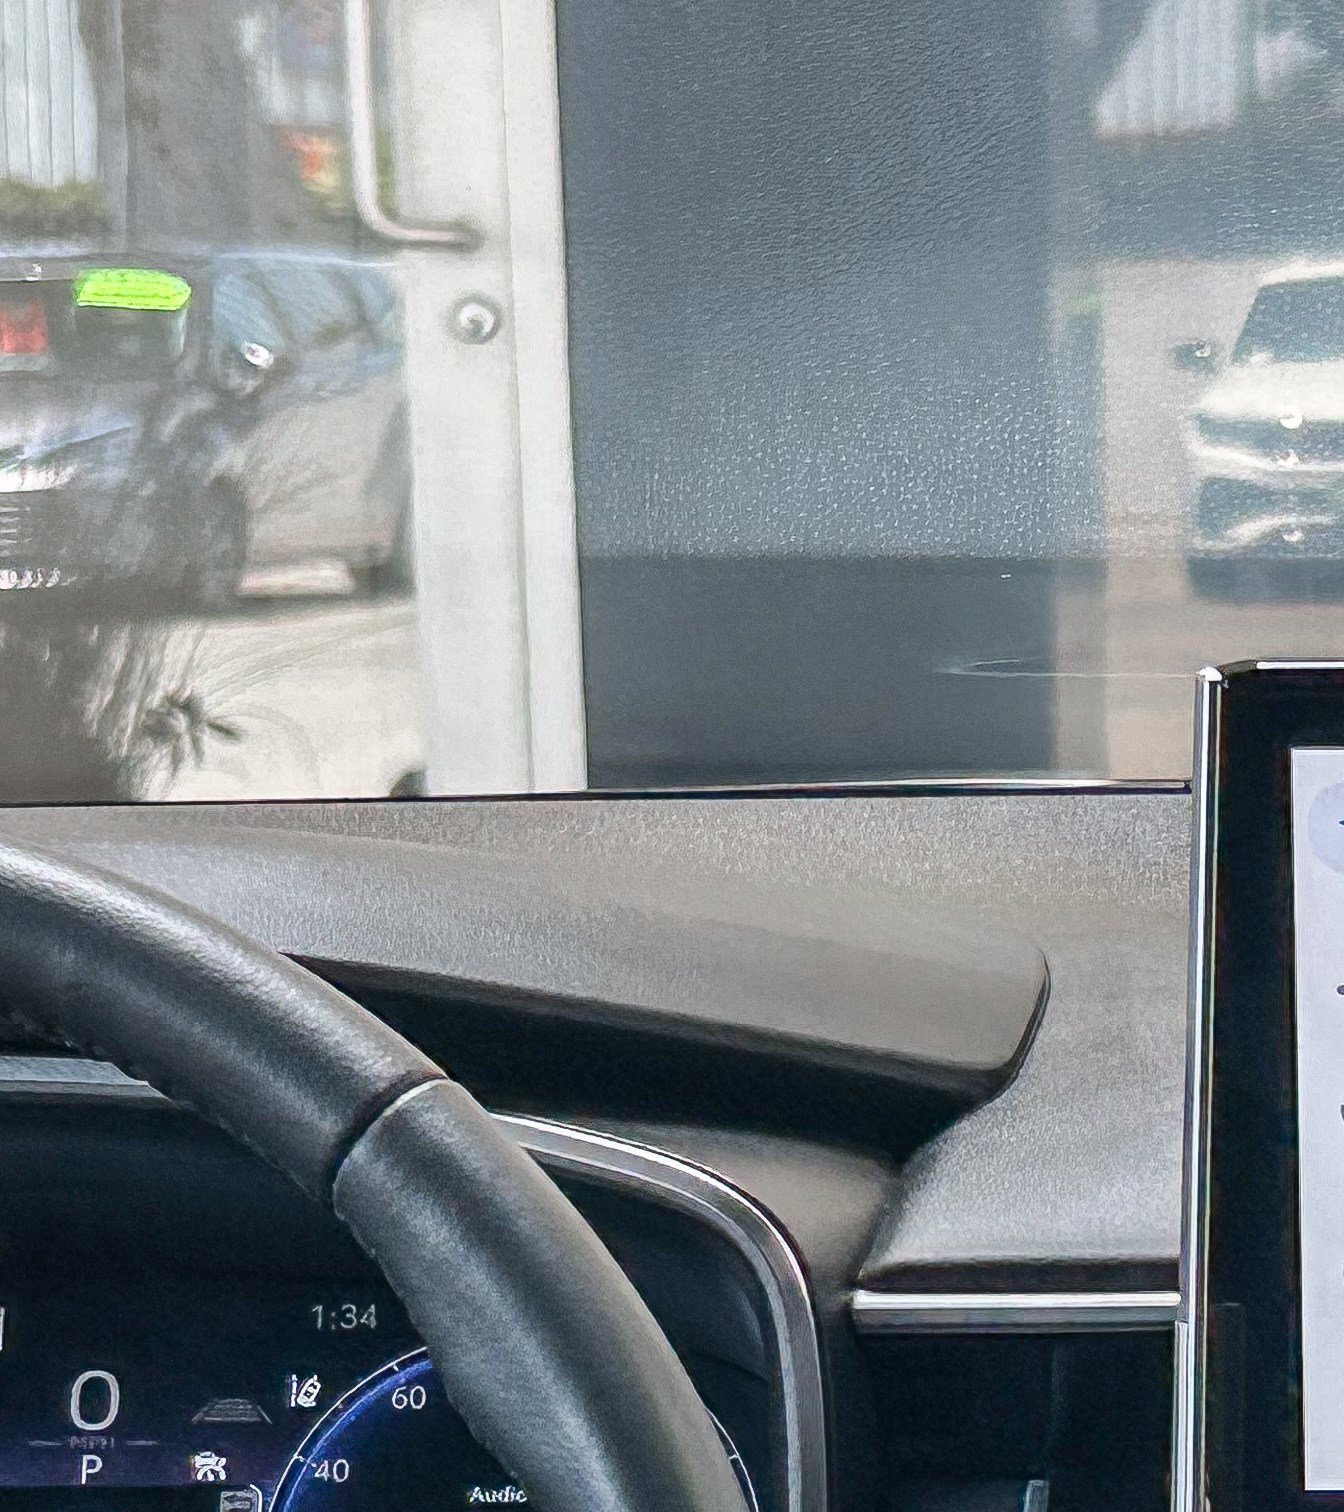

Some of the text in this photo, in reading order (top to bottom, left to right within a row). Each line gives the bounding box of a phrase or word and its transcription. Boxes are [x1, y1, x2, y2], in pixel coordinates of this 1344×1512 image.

[311, 1304, 377, 1331] 1:34
[70, 1369, 120, 1432] 0
[391, 1385, 427, 1410] 60
[80, 1454, 103, 1485] P
[314, 1459, 350, 1483] 40
